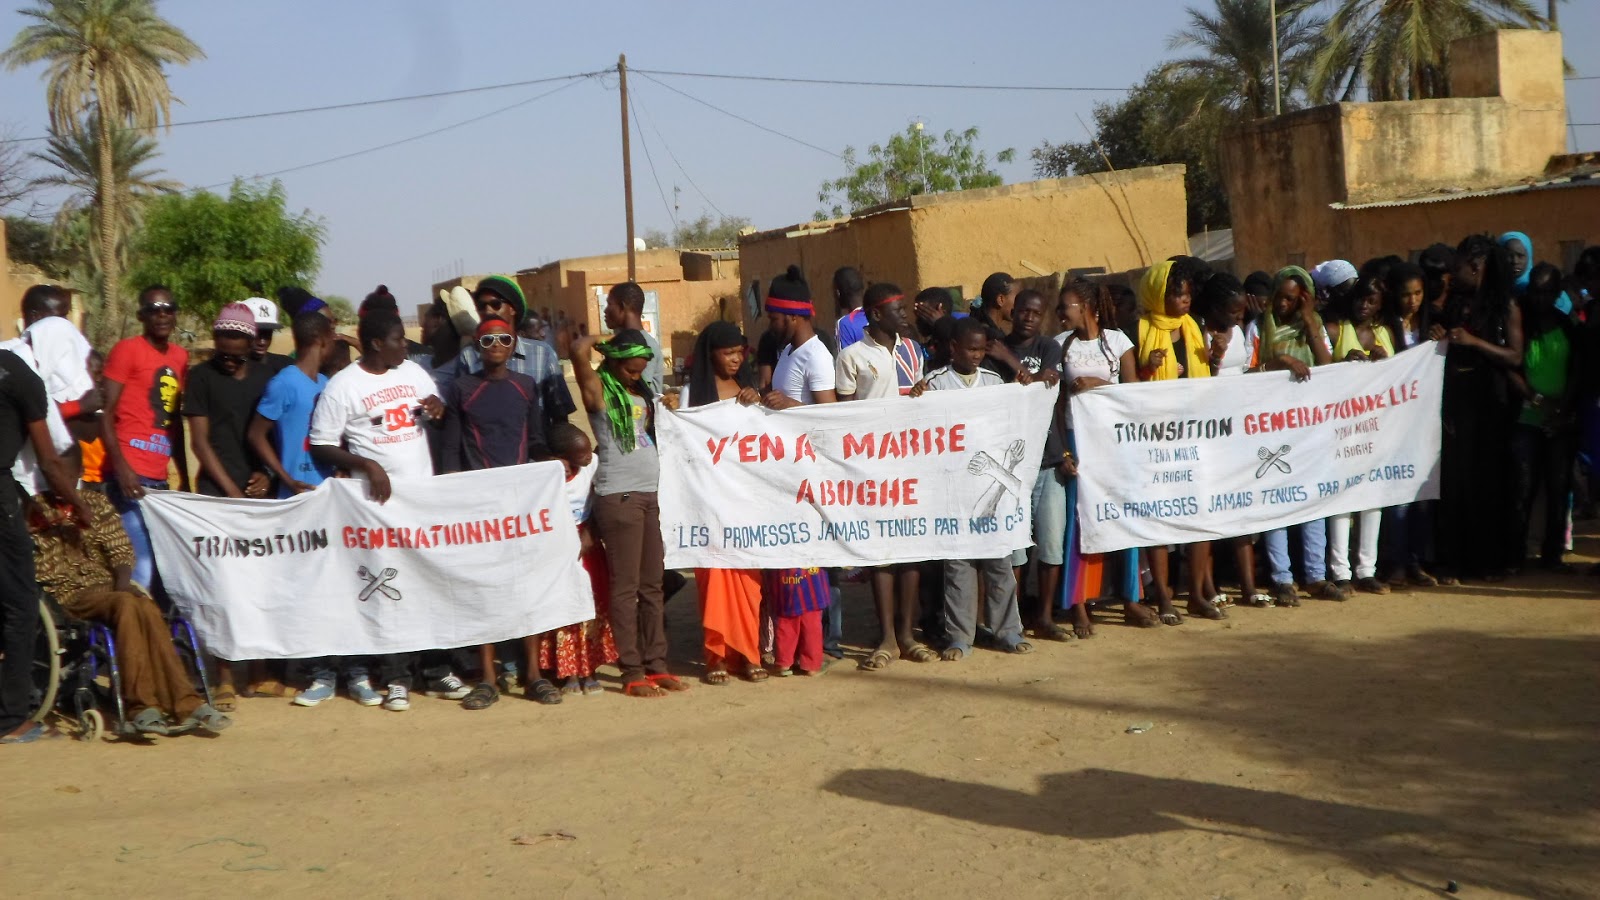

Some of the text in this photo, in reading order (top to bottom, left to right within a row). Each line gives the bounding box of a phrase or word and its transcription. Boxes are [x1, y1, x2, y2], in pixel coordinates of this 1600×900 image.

[384, 404, 416, 431] DC
[1114, 380, 1419, 443] TRANSITION GENERATIONNELLE
[706, 431, 786, 466] Y'EN
[842, 423, 966, 460] MARRE
[1096, 502, 1120, 523] LES
[1123, 496, 1198, 518] PROMESSES
[1208, 491, 1253, 513] JAMAIS
[1261, 485, 1308, 505] TENUES
[1318, 480, 1340, 498] PAR
[1369, 464, 1416, 483] CADRES
[192, 508, 554, 558] TRANSITION GENERATIONNELLE
[678, 525, 710, 549] LES
[723, 521, 811, 549] PROMESSES
[817, 519, 870, 542] JAMAIS
[875, 516, 927, 538] TENUES
[934, 517, 959, 535] PAR
[969, 516, 999, 534] NOS
